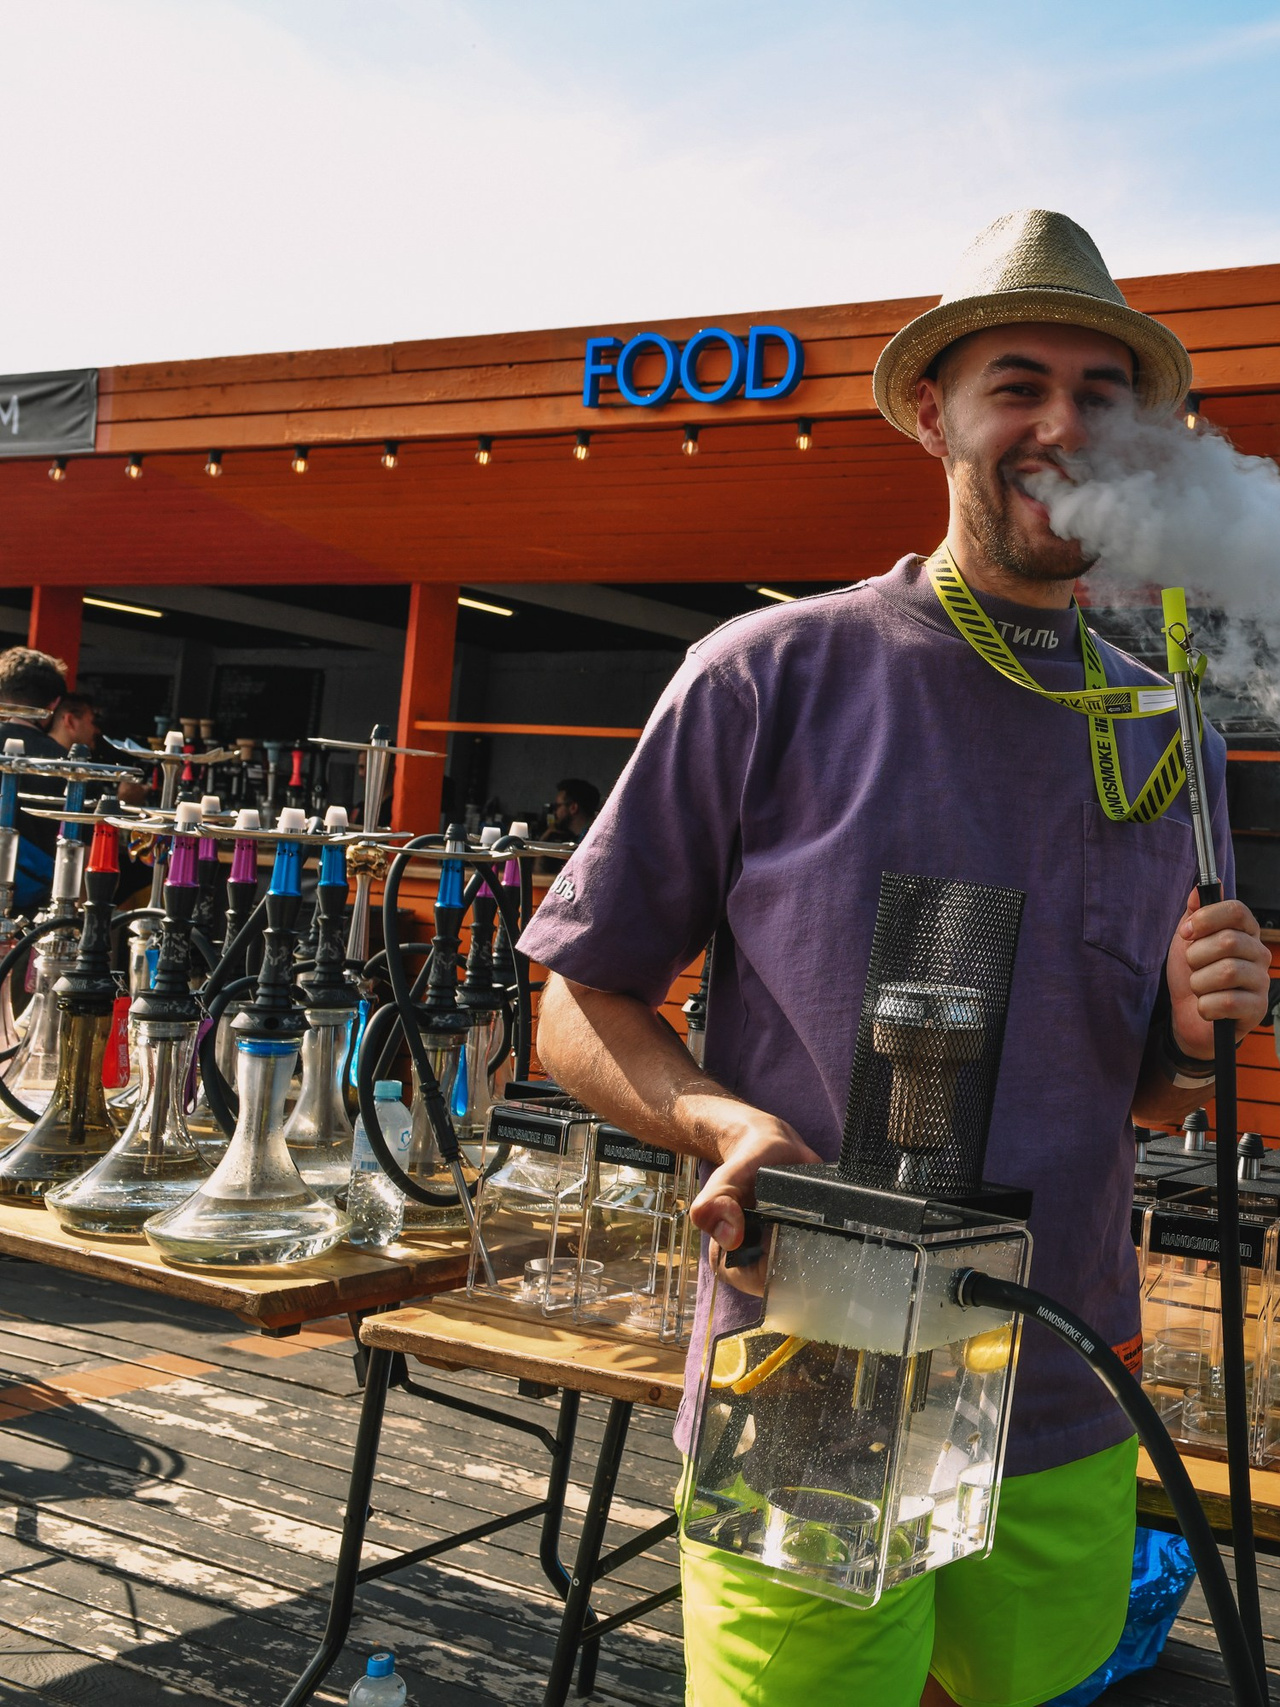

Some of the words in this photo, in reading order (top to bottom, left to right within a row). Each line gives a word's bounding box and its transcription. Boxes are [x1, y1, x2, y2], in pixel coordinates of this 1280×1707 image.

[582, 325, 804, 408] FOOD
[1095, 717, 1109, 733] ili
[1160, 1232, 1220, 1253] NANOSMOK
[1036, 1305, 1082, 1342] NANOSMOKE
